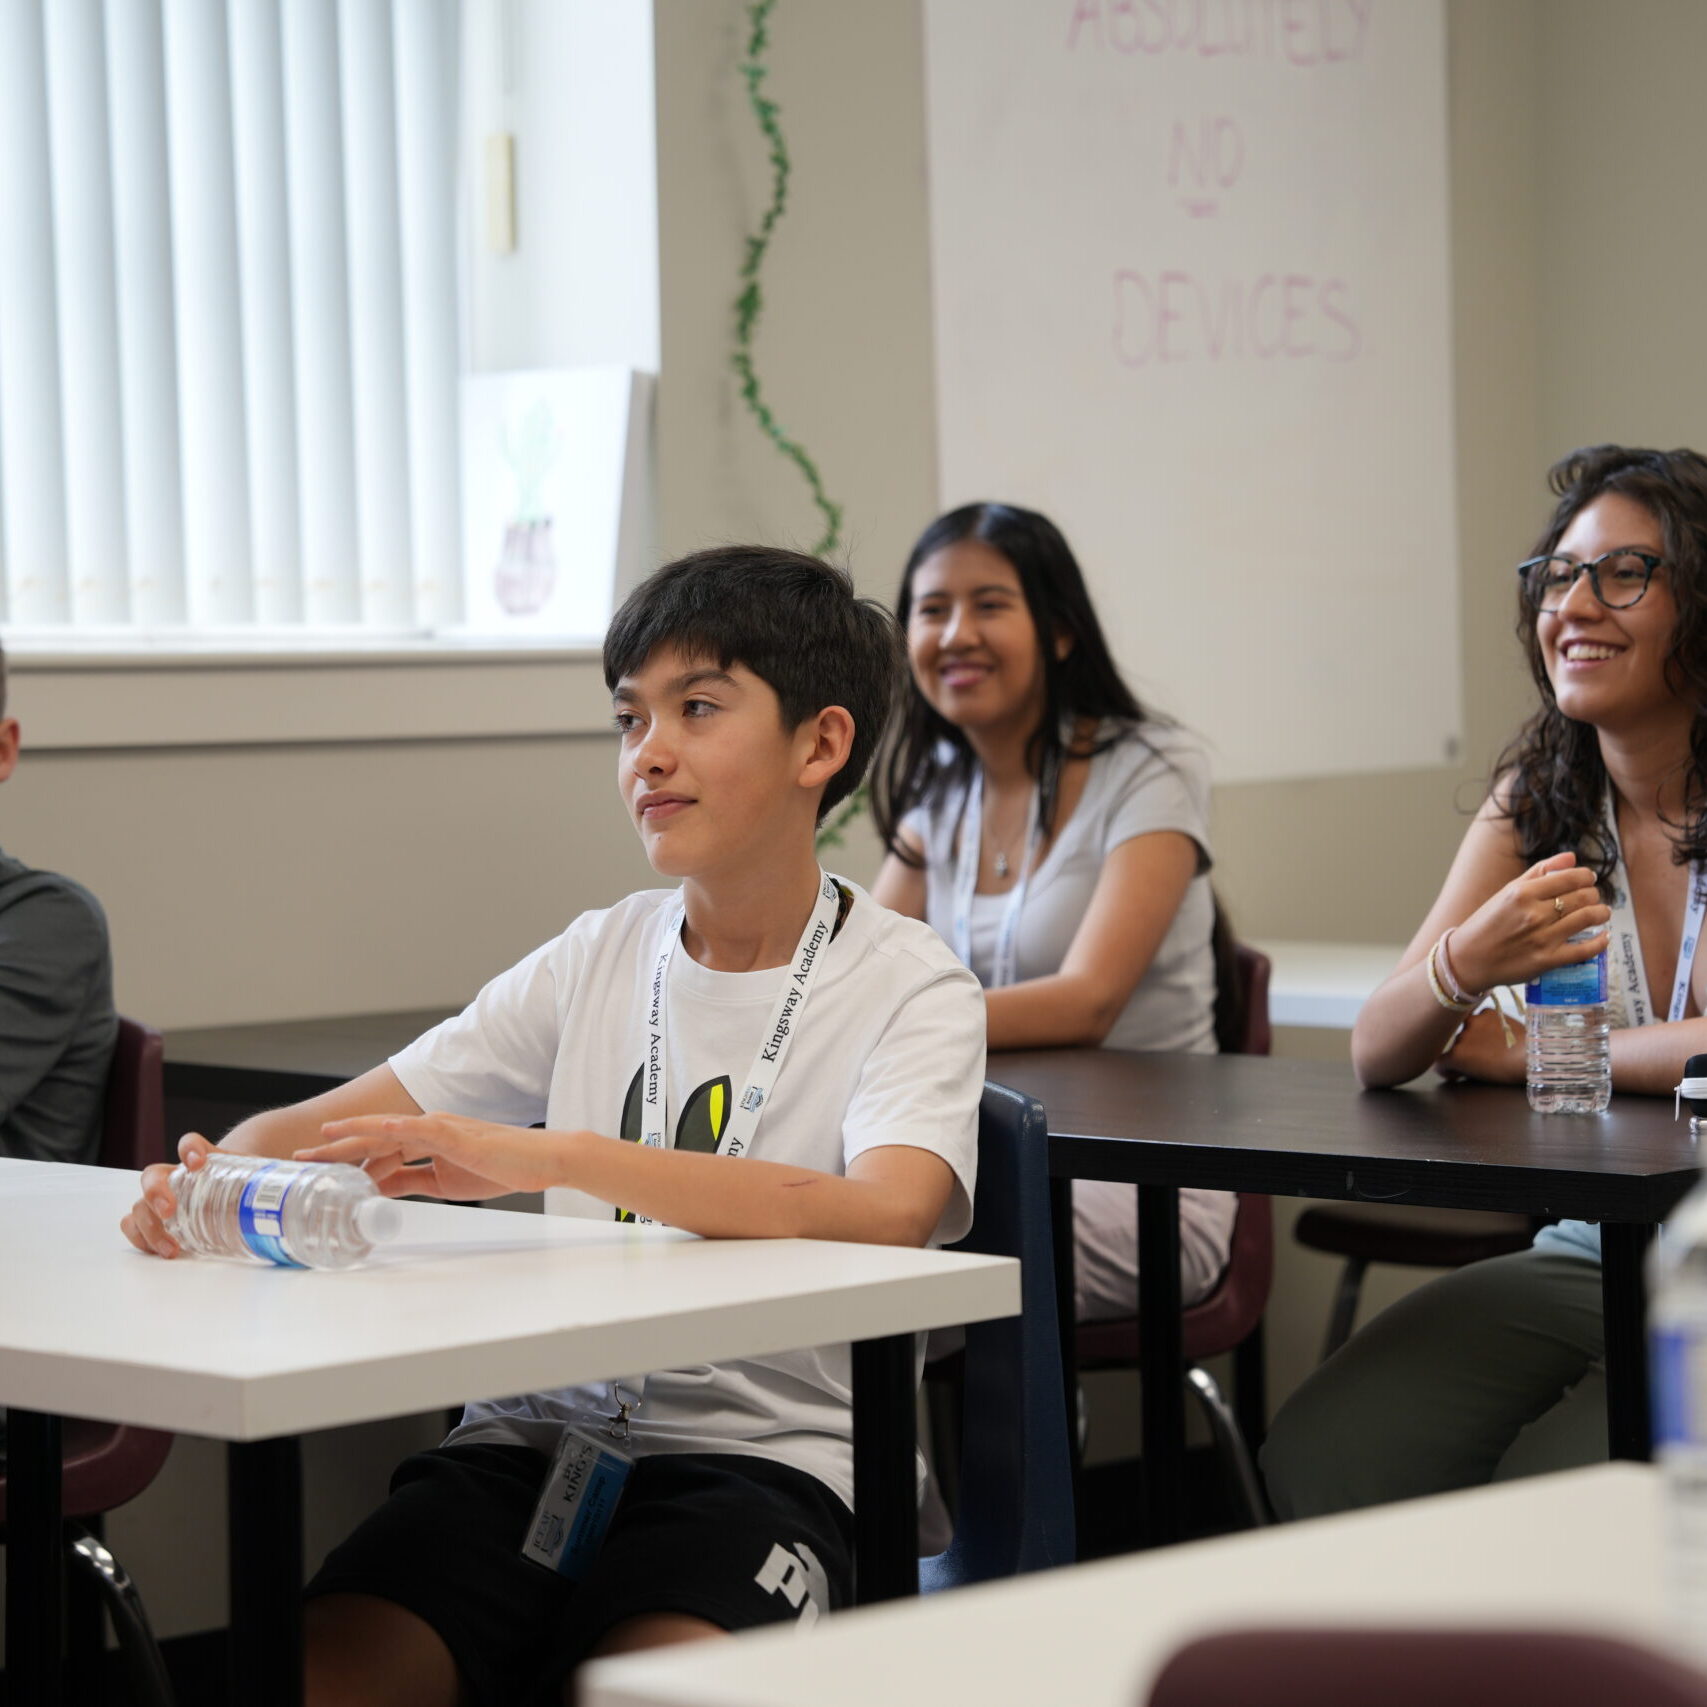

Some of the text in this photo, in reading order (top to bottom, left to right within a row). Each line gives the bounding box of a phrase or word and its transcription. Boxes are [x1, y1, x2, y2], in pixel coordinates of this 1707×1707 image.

[1167, 116, 1246, 189] NO
[1111, 267, 1363, 368] DEVICES
[760, 919, 829, 1063] Kingsway Academy
[1621, 932, 1640, 993] Academy
[646, 952, 669, 1105] Kingsway Academy
[562, 1444, 592, 1502] KING'S
